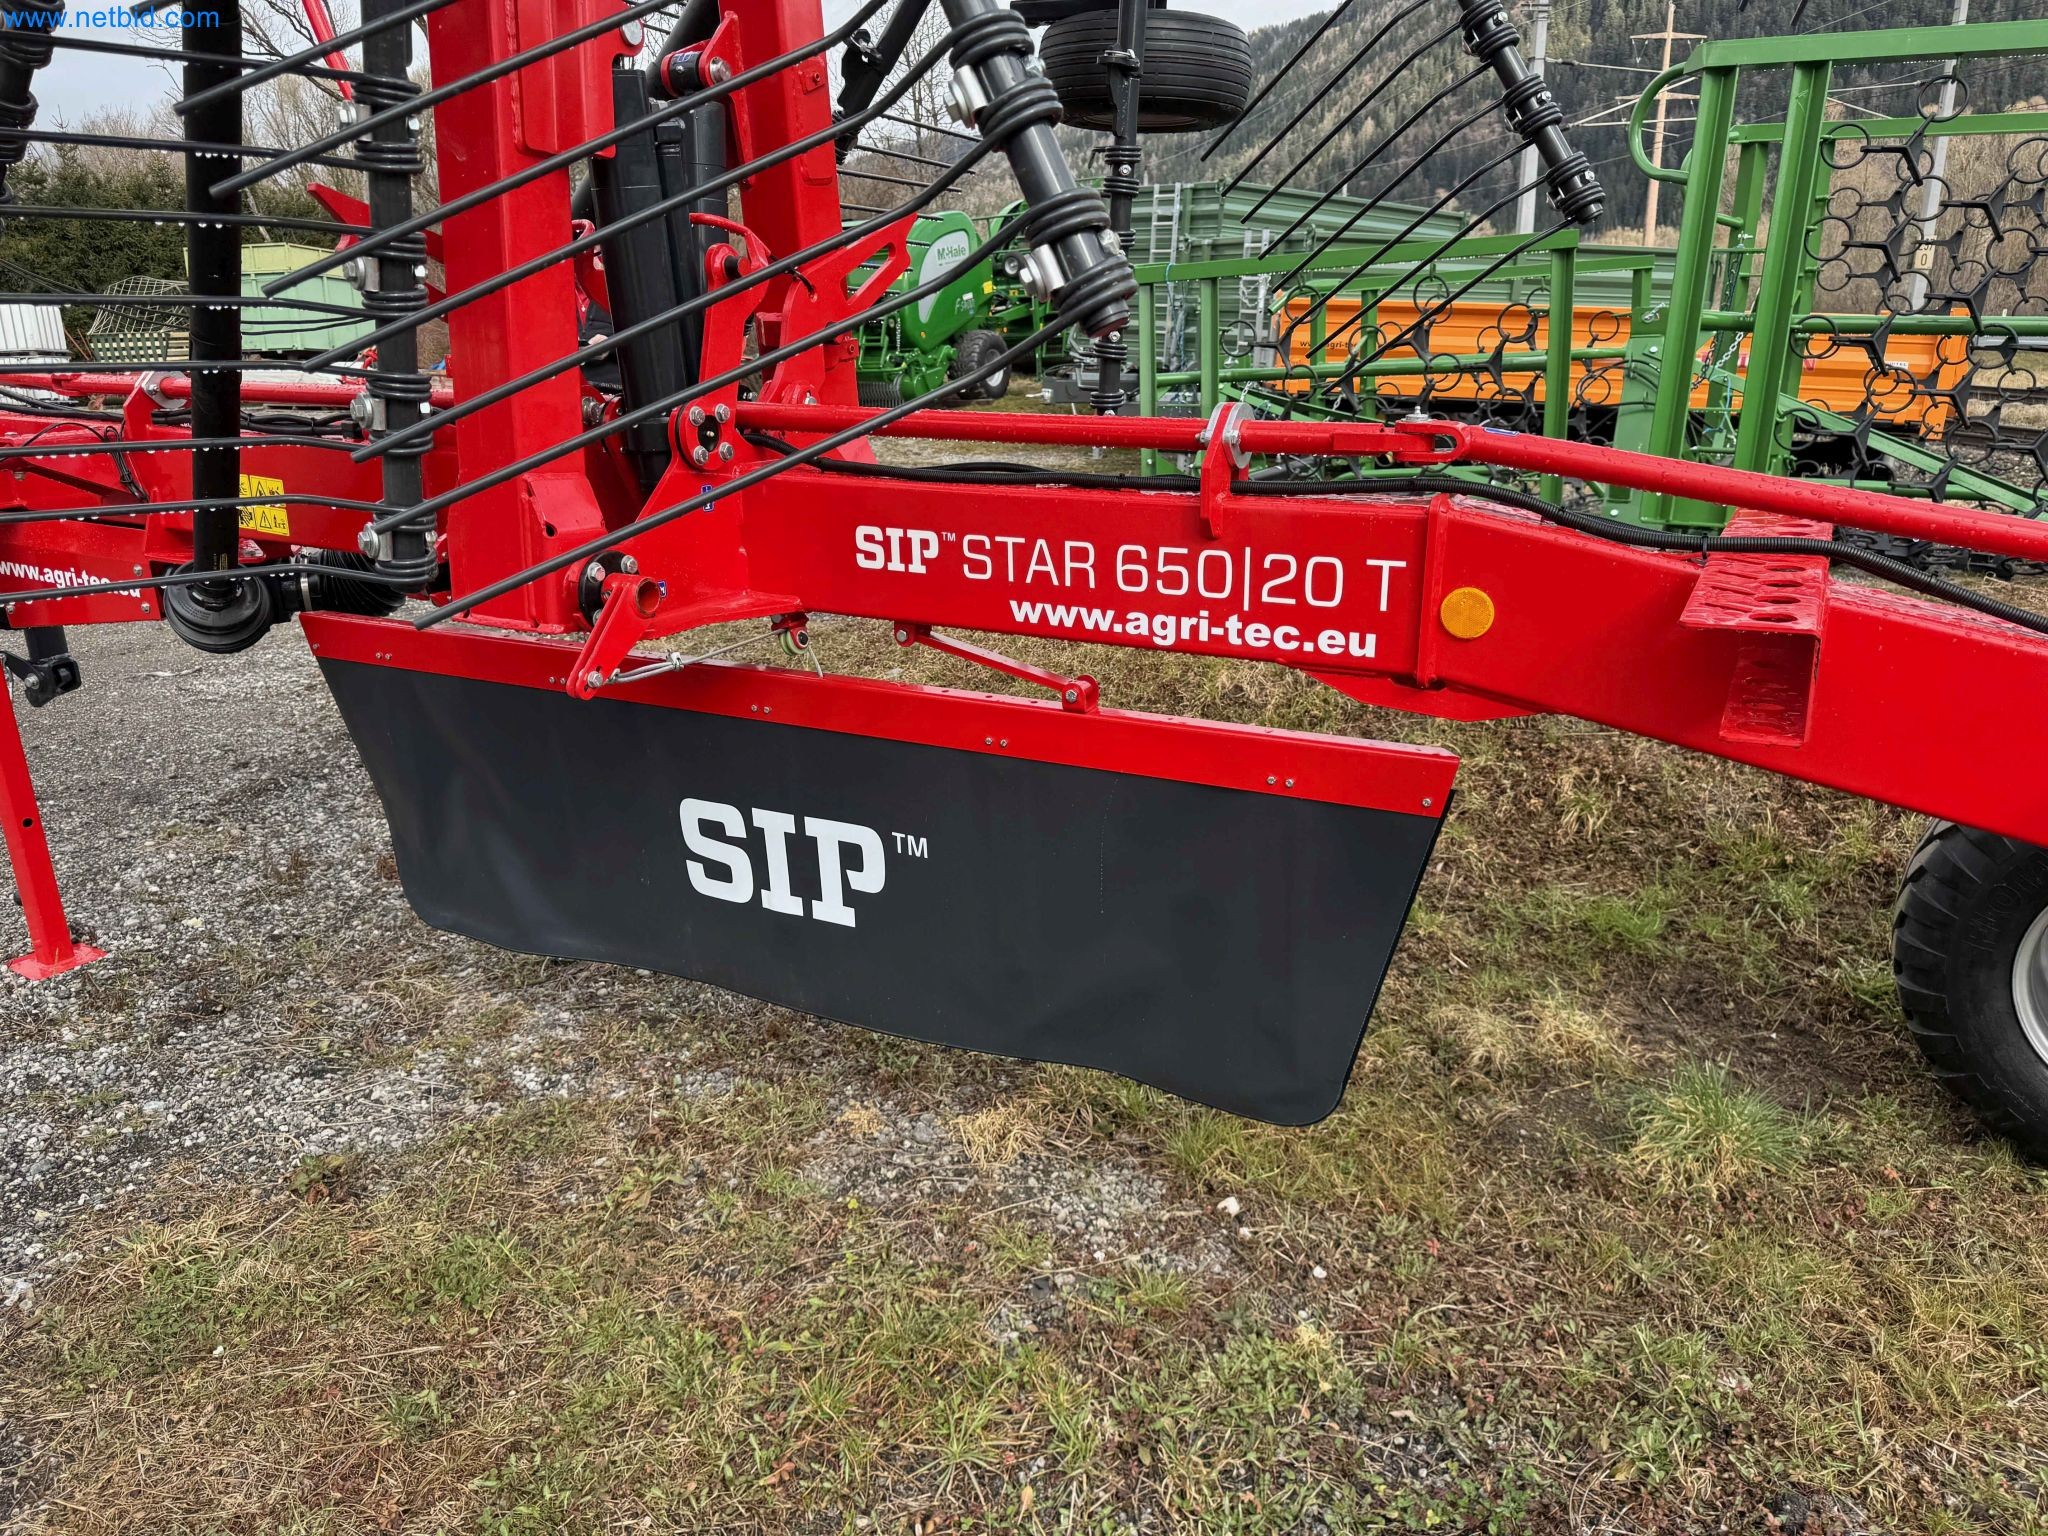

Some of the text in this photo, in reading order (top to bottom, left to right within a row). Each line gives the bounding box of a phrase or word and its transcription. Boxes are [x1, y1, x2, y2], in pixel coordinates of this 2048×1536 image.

[855, 525, 939, 574] SIP
[962, 534, 1096, 589] STAR
[1366, 559, 1407, 612] T
[1009, 600, 1377, 658] www.agri-tec.eu
[679, 797, 886, 928] SIP
